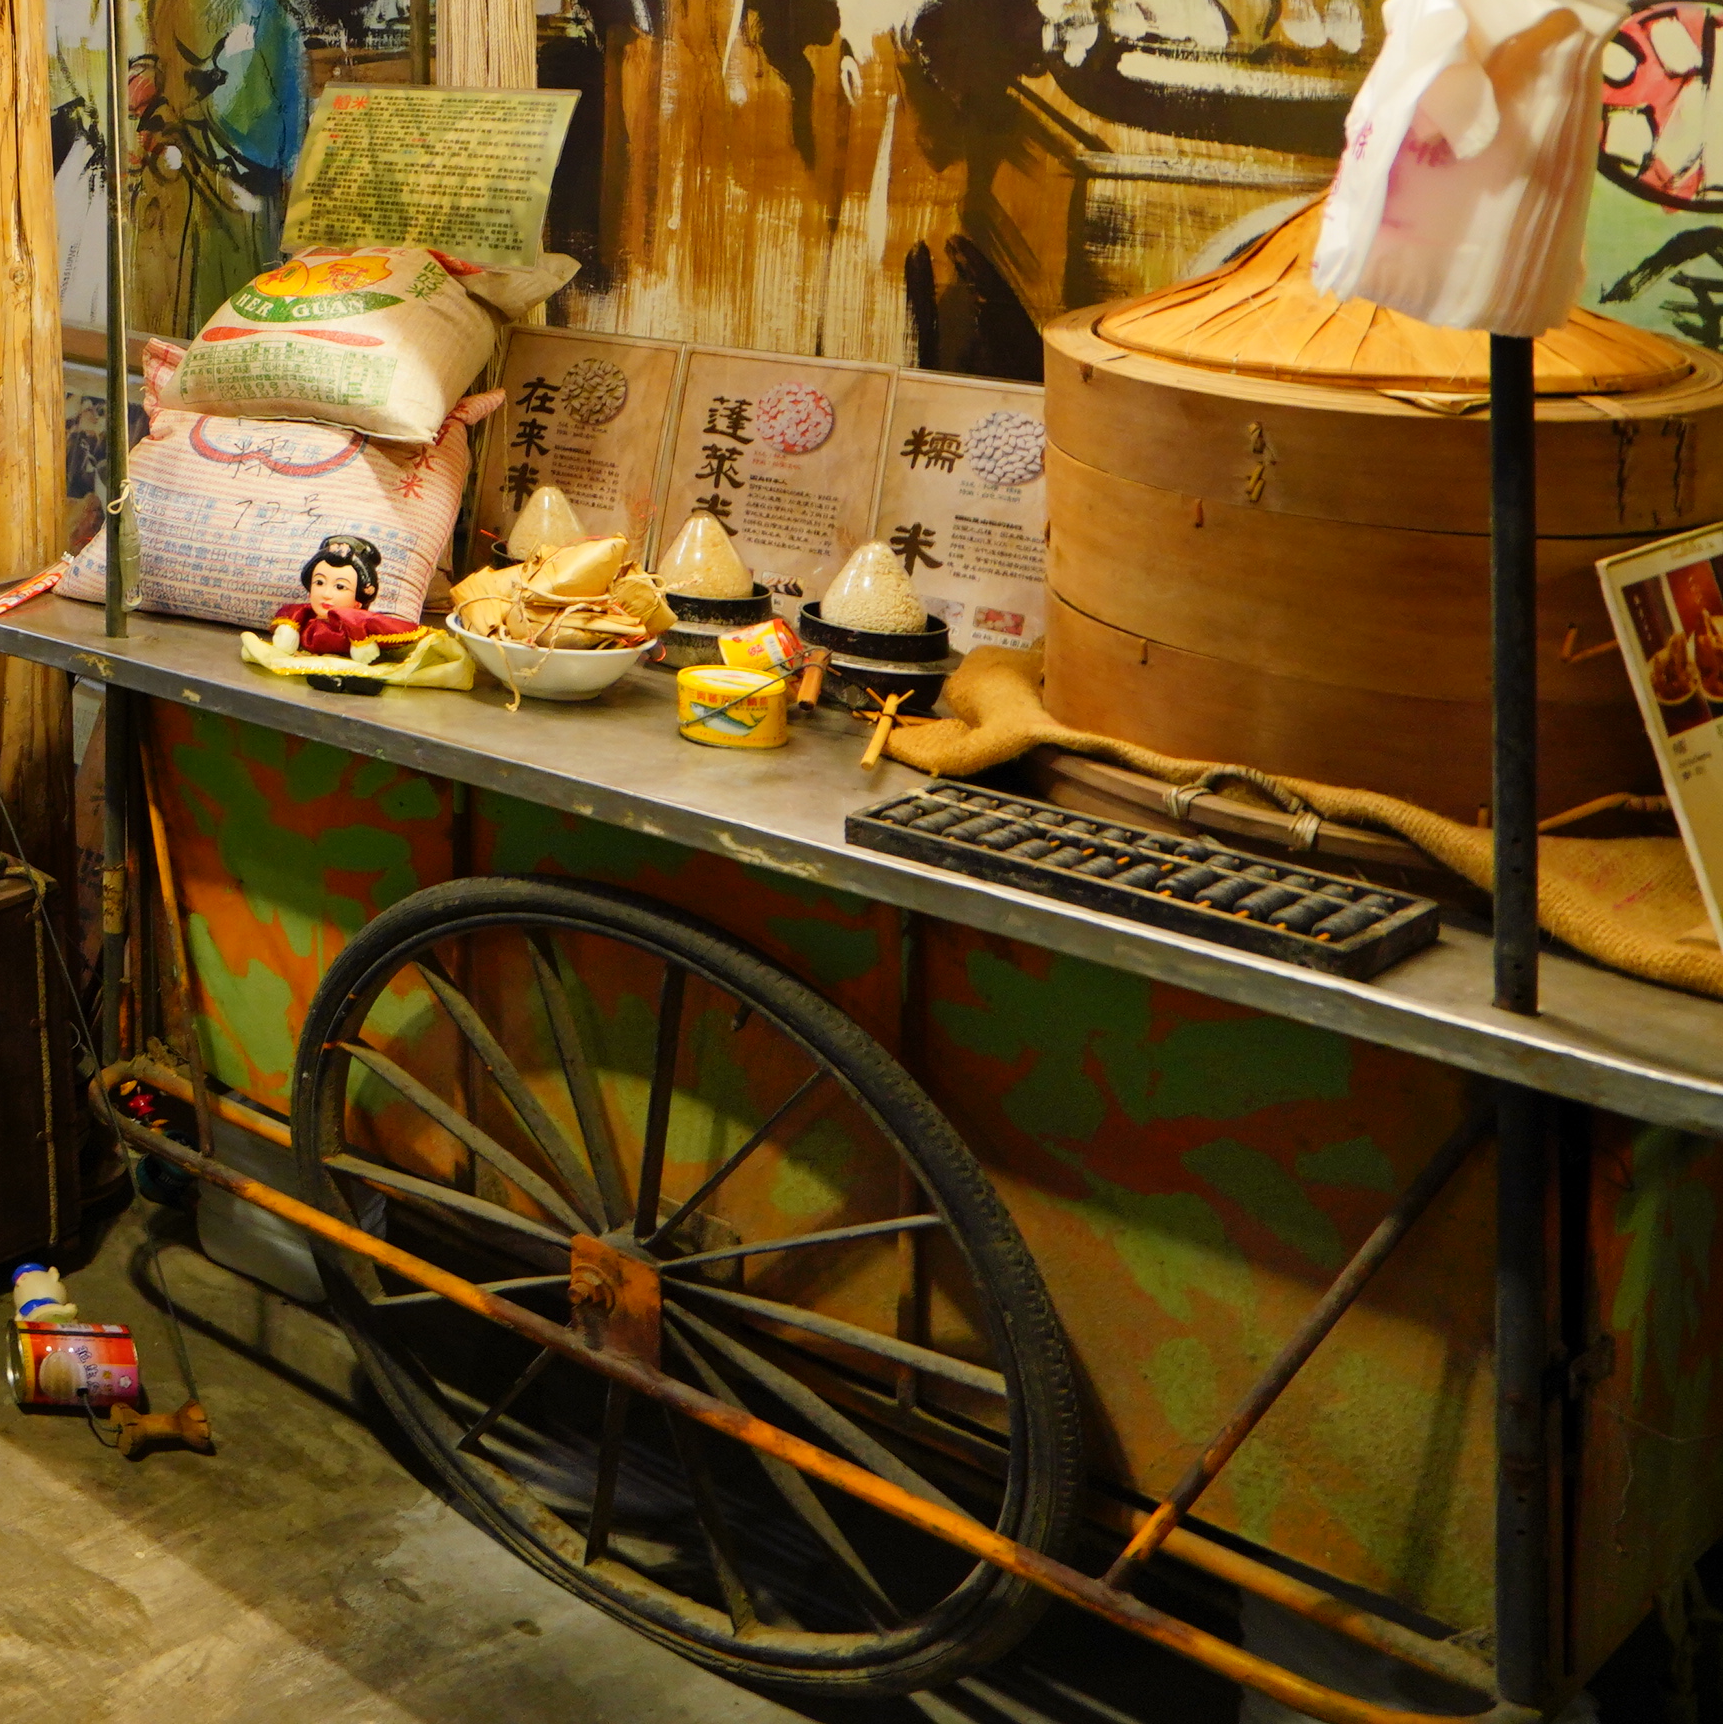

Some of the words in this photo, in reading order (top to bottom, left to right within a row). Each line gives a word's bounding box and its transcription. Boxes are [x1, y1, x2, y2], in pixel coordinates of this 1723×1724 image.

[236, 291, 275, 318] HER
[292, 295, 365, 319] GUAN
[499, 376, 562, 513] 在來米
[691, 395, 755, 537] 蓬萊米
[890, 426, 965, 578] 糯米
